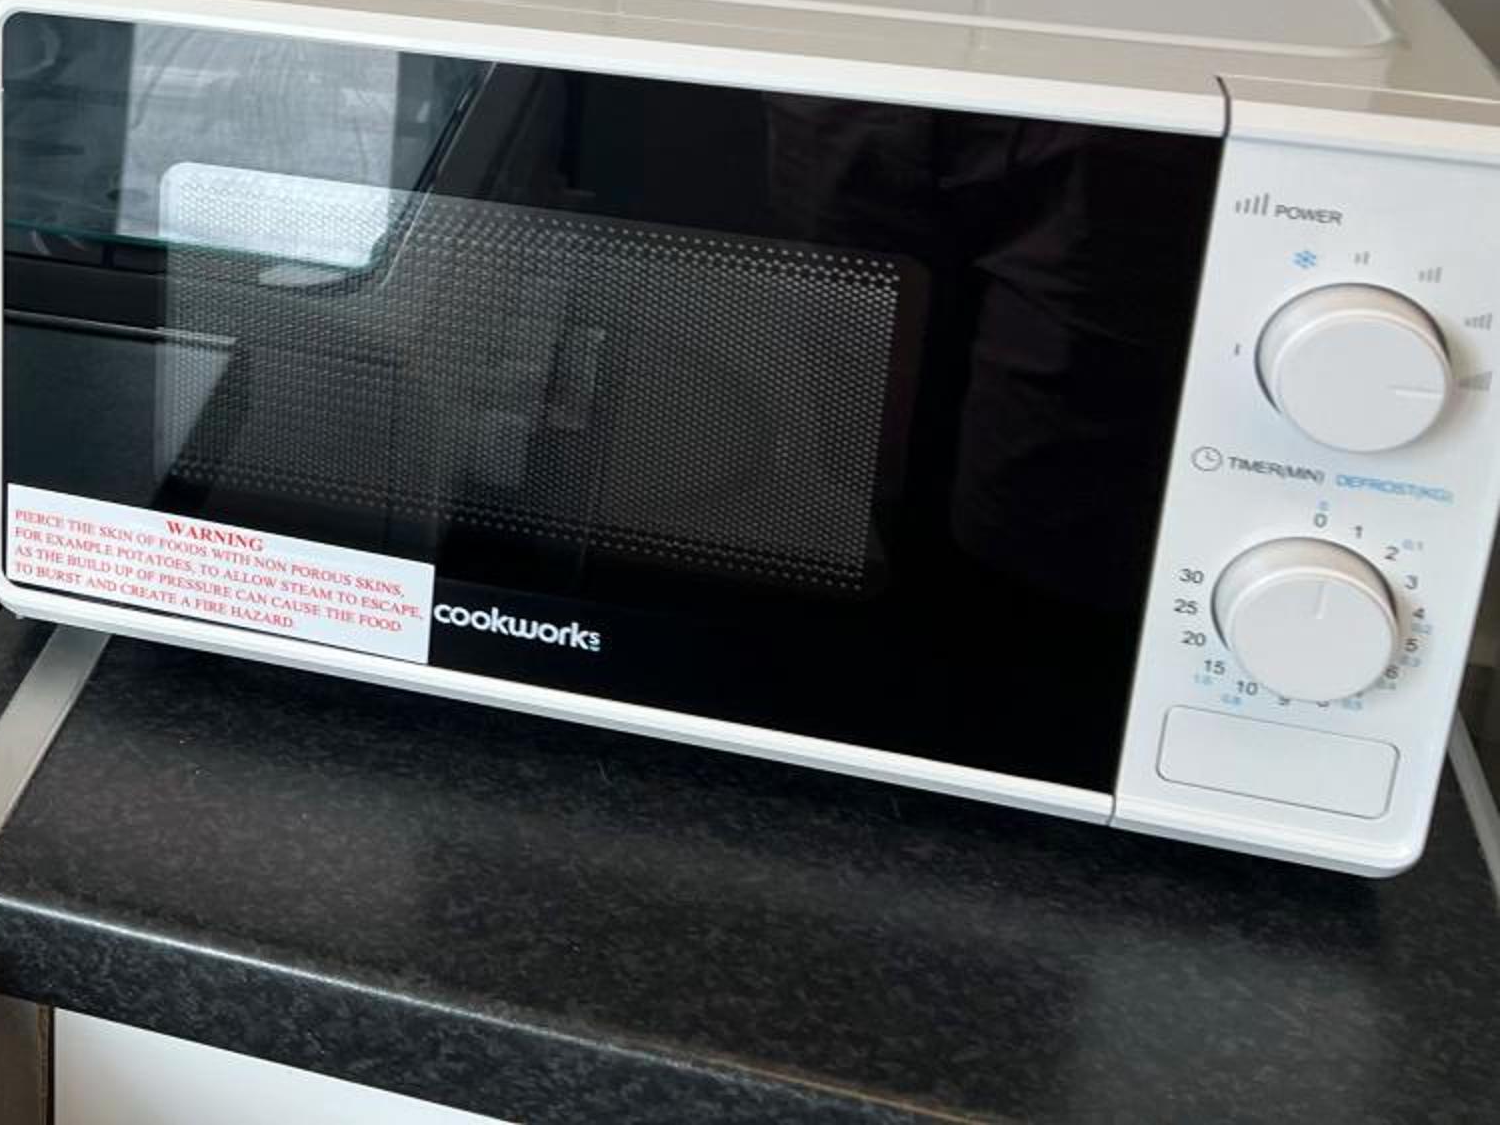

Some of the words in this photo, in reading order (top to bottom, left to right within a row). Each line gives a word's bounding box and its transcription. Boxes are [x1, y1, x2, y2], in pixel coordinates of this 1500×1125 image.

[1274, 203, 1343, 226] POWER
[166, 519, 264, 552] WARNING
[1354, 525, 1363, 539] 1
[15, 509, 65, 526] PIERCE
[67, 519, 95, 534] THE
[99, 526, 133, 543] SKIN
[136, 533, 157, 546] OF
[159, 538, 207, 557] FOODS
[211, 547, 251, 566] WITH
[253, 555, 288, 573] NON
[291, 563, 352, 586] POROUS
[355, 577, 405, 598] SKINS,
[1383, 545, 1400, 562] 2
[15, 526, 42, 541] FOR
[45, 532, 113, 555] EXAMPLE
[200, 562, 220, 576] TO
[224, 567, 278, 588] ALLOW
[280, 580, 333, 601] STEAM
[336, 590, 358, 605] TO
[1178, 567, 1206, 585] 30
[1404, 573, 1419, 591] 3
[14, 544, 33, 558] AS
[36, 548, 65, 564] THE
[67, 553, 111, 573] BUILD
[114, 562, 133, 577] UP
[136, 566, 157, 581] OF
[159, 571, 234, 598] PRESSURE
[235, 589, 268, 607] CAN
[271, 595, 321, 616] CAUSE
[324, 606, 356, 623] THE
[358, 613, 402, 632] FOOD
[14, 561, 33, 576] TO
[35, 565, 82, 585] BURST
[86, 575, 118, 592] AND
[119, 580, 178, 605] CREATE
[180, 596, 191, 607] A
[195, 598, 227, 616] FIRE
[230, 606, 293, 628] HAZARD
[1172, 597, 1199, 615] 25
[1411, 607, 1426, 621] 4
[433, 603, 601, 652] cookworks
[1180, 629, 1207, 648] 20
[1403, 637, 1420, 653] 5
[1203, 658, 1227, 676] 15
[1235, 679, 1259, 697] 10
